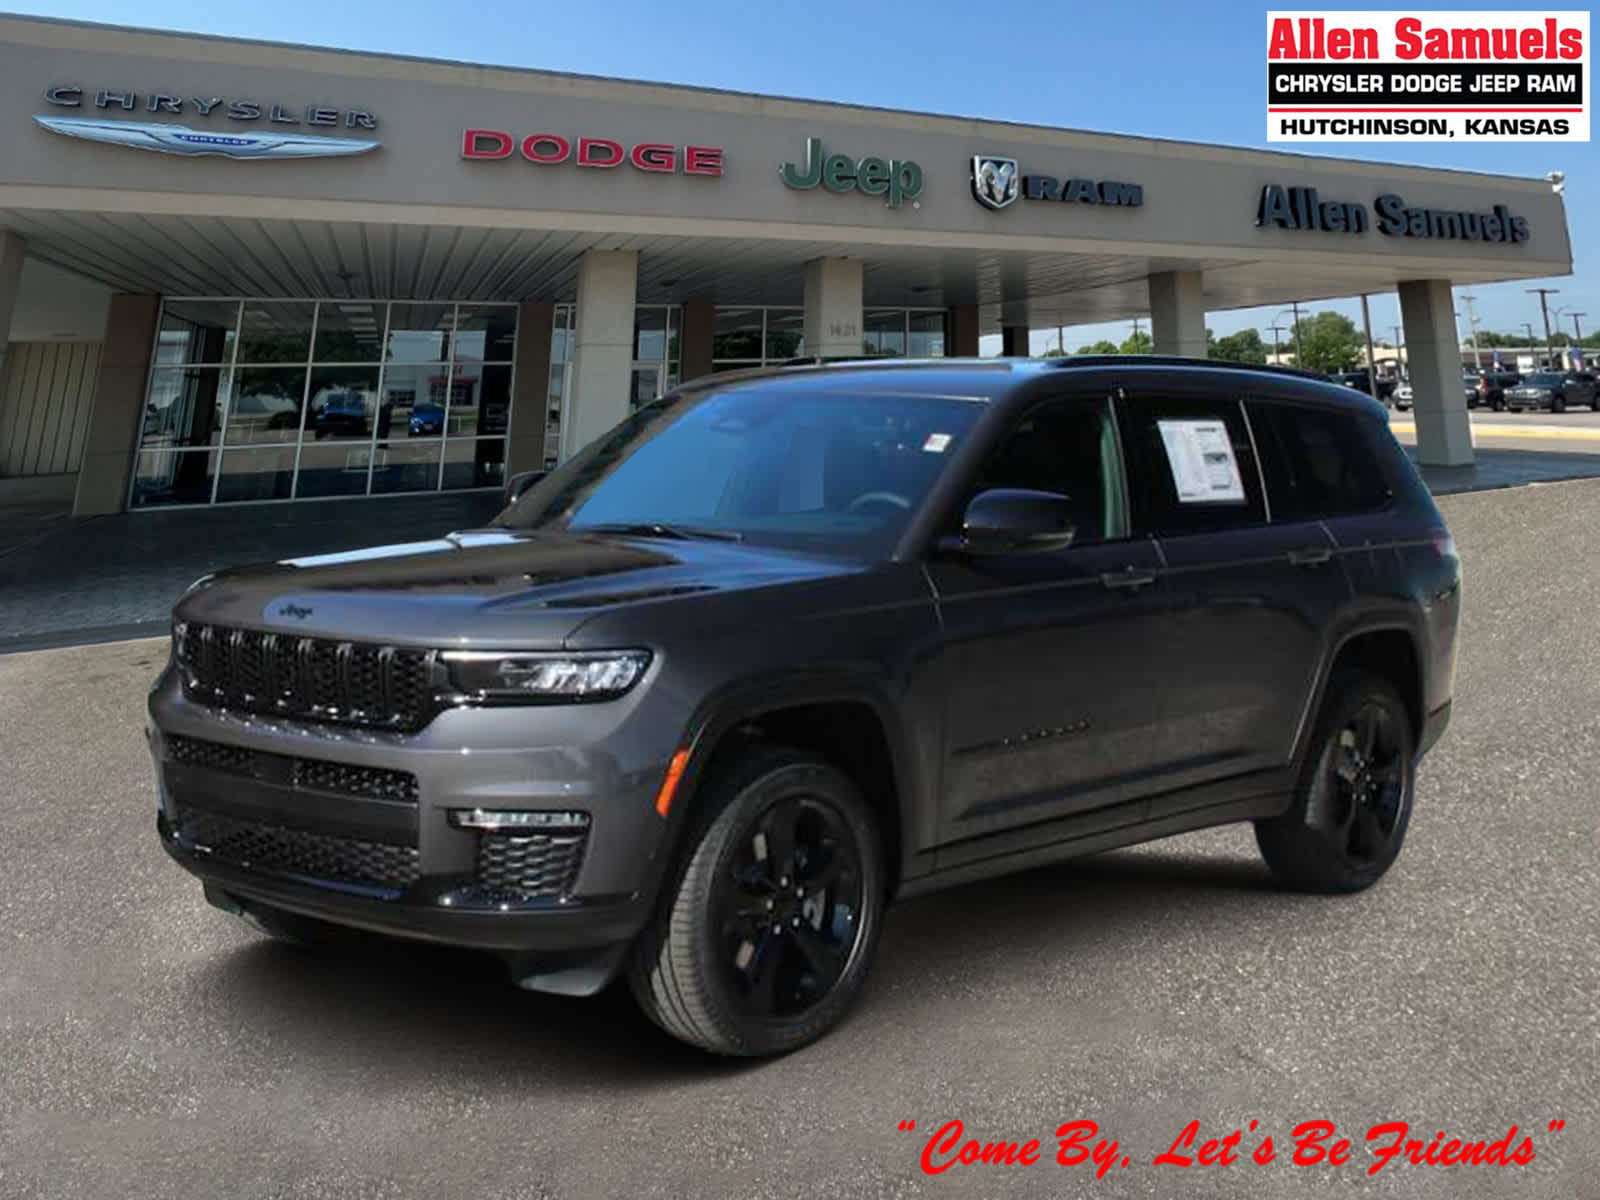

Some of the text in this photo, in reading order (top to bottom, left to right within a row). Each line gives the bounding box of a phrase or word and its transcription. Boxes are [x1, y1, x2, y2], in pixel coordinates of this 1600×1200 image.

[43, 86, 378, 129] CHRYSLER
[461, 128, 725, 177] DODGE
[779, 137, 923, 209] Jeep
[1022, 174, 1144, 207] RAM
[1255, 184, 1531, 243] Allen Samuels
